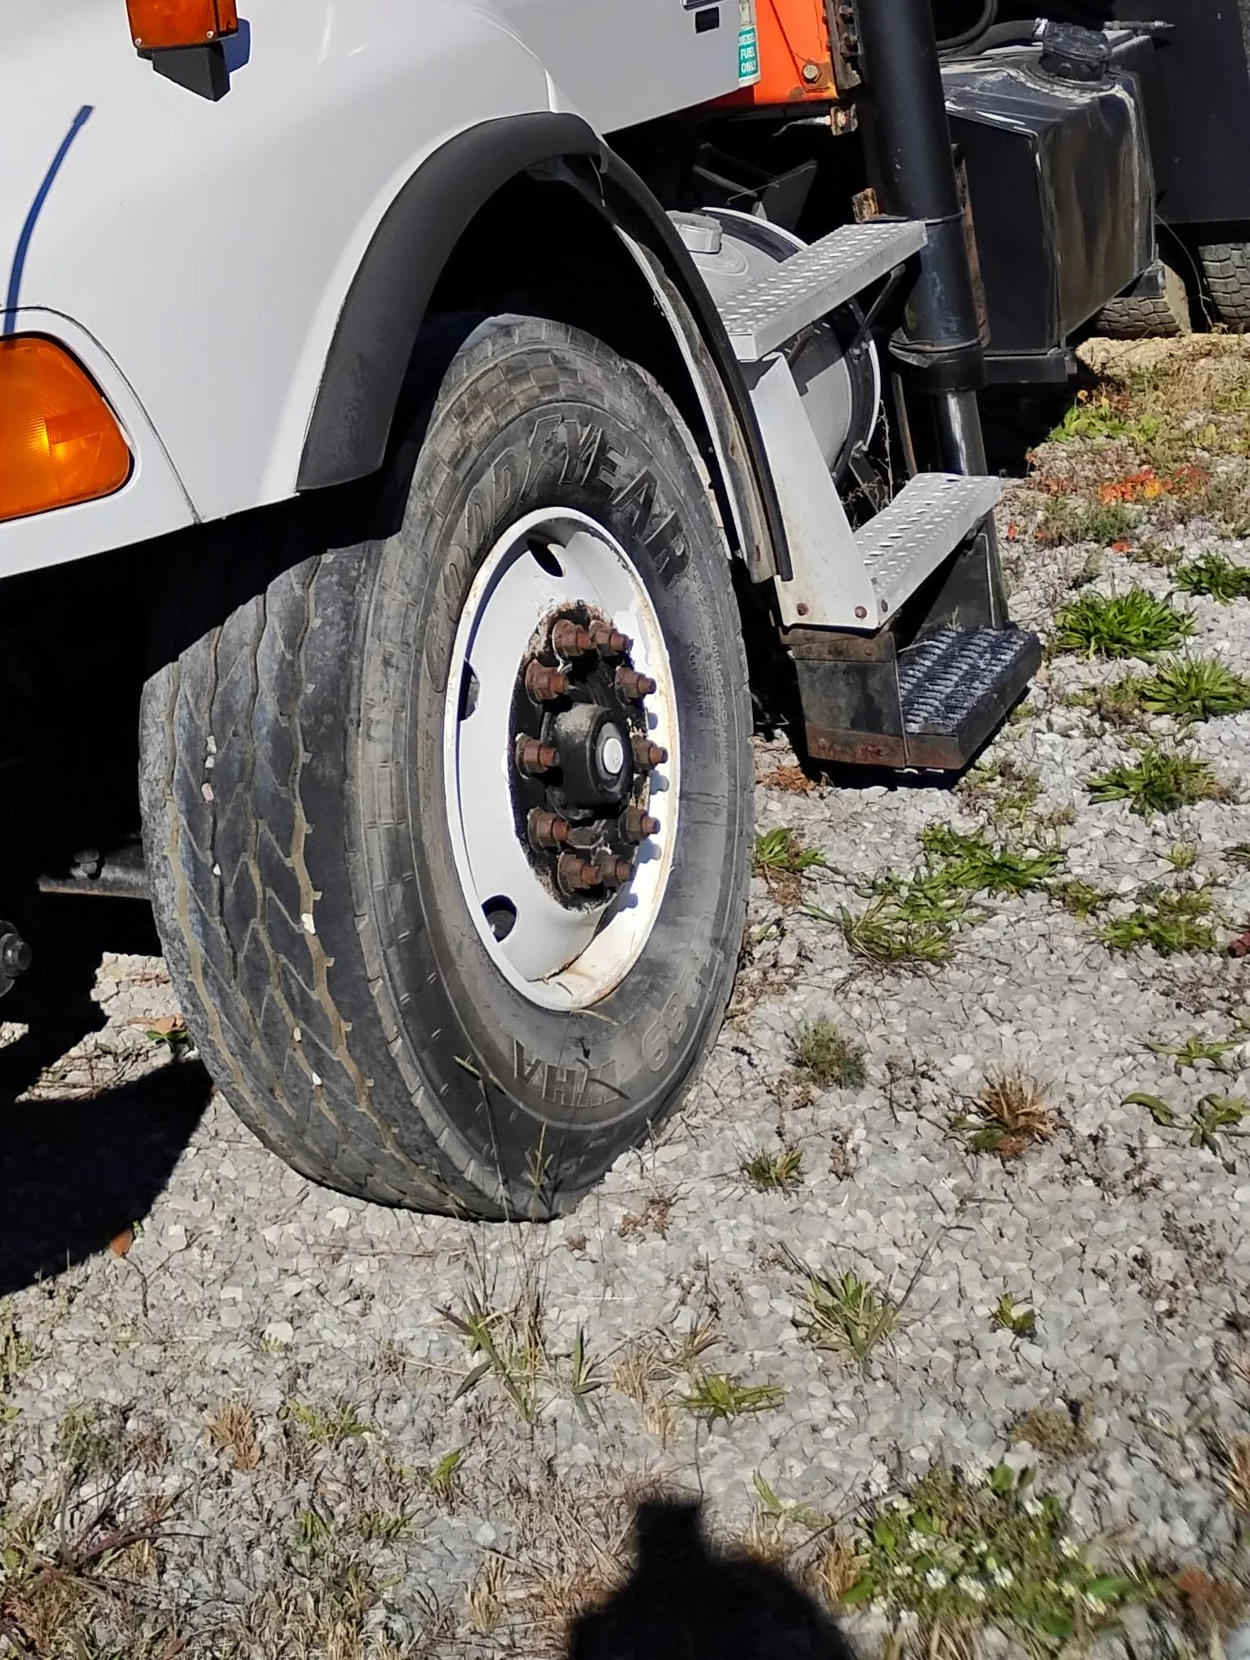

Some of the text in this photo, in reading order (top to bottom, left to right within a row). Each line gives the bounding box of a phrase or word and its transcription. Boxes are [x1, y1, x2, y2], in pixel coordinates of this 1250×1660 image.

[740, 46, 755, 61] FUEL
[740, 60, 756, 74] ONLY
[424, 413, 692, 694] GOODYEAR
